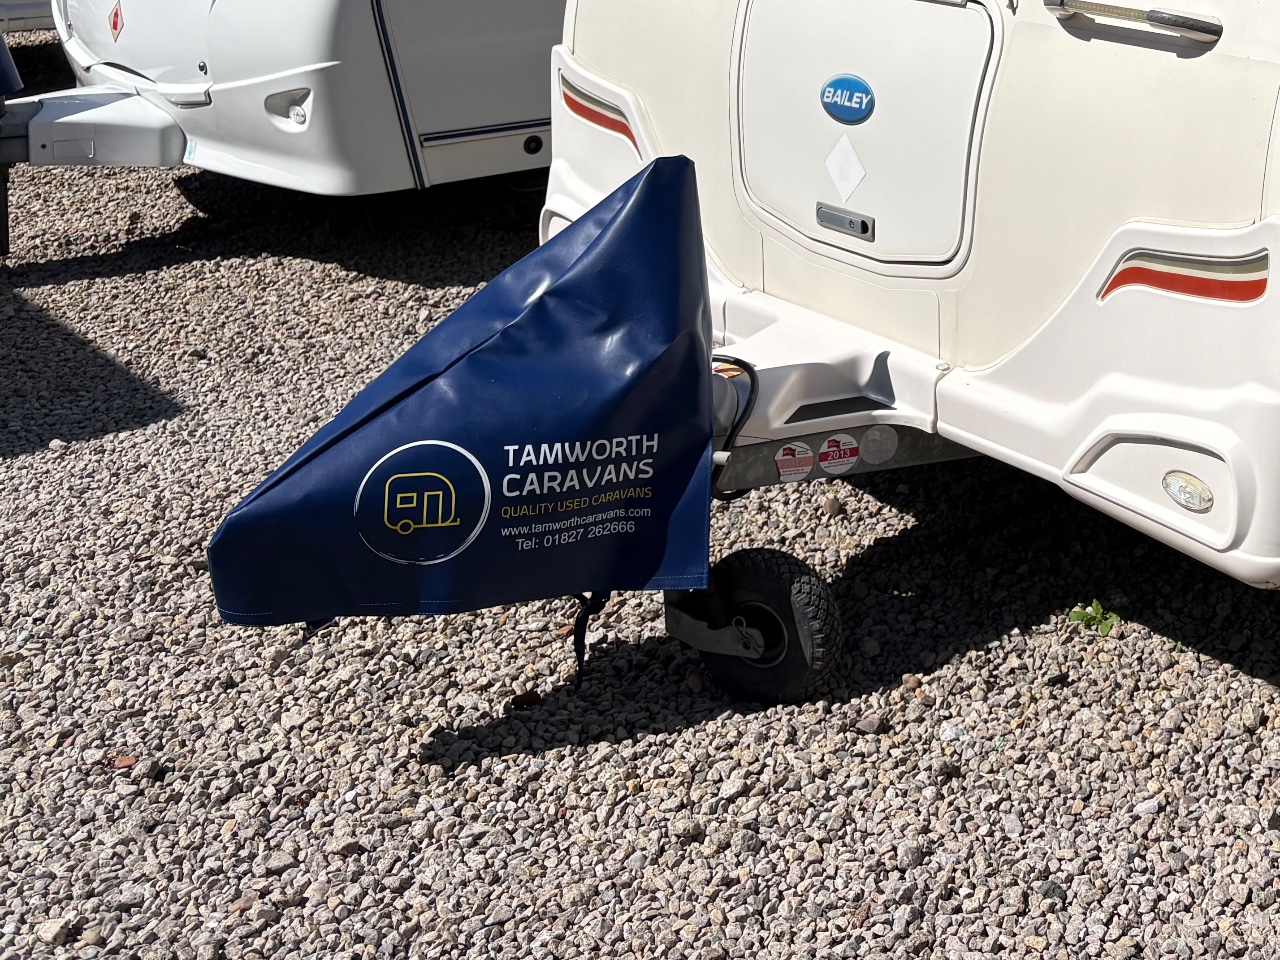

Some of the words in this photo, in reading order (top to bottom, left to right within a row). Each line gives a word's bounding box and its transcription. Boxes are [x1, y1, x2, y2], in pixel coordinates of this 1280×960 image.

[823, 87, 872, 110] BAILEY
[503, 433, 659, 467] TAMWORTH
[828, 448, 851, 461] 2013
[502, 458, 654, 497] CARAVANS
[501, 503, 555, 519] QUALITY
[557, 497, 589, 512] USED
[592, 486, 653, 506] CARAVANS
[501, 507, 651, 537] www.tamworthcaravans.com
[515, 538, 539, 551] Tel:
[543, 528, 584, 547] 01827
[587, 521, 636, 538] 262666
